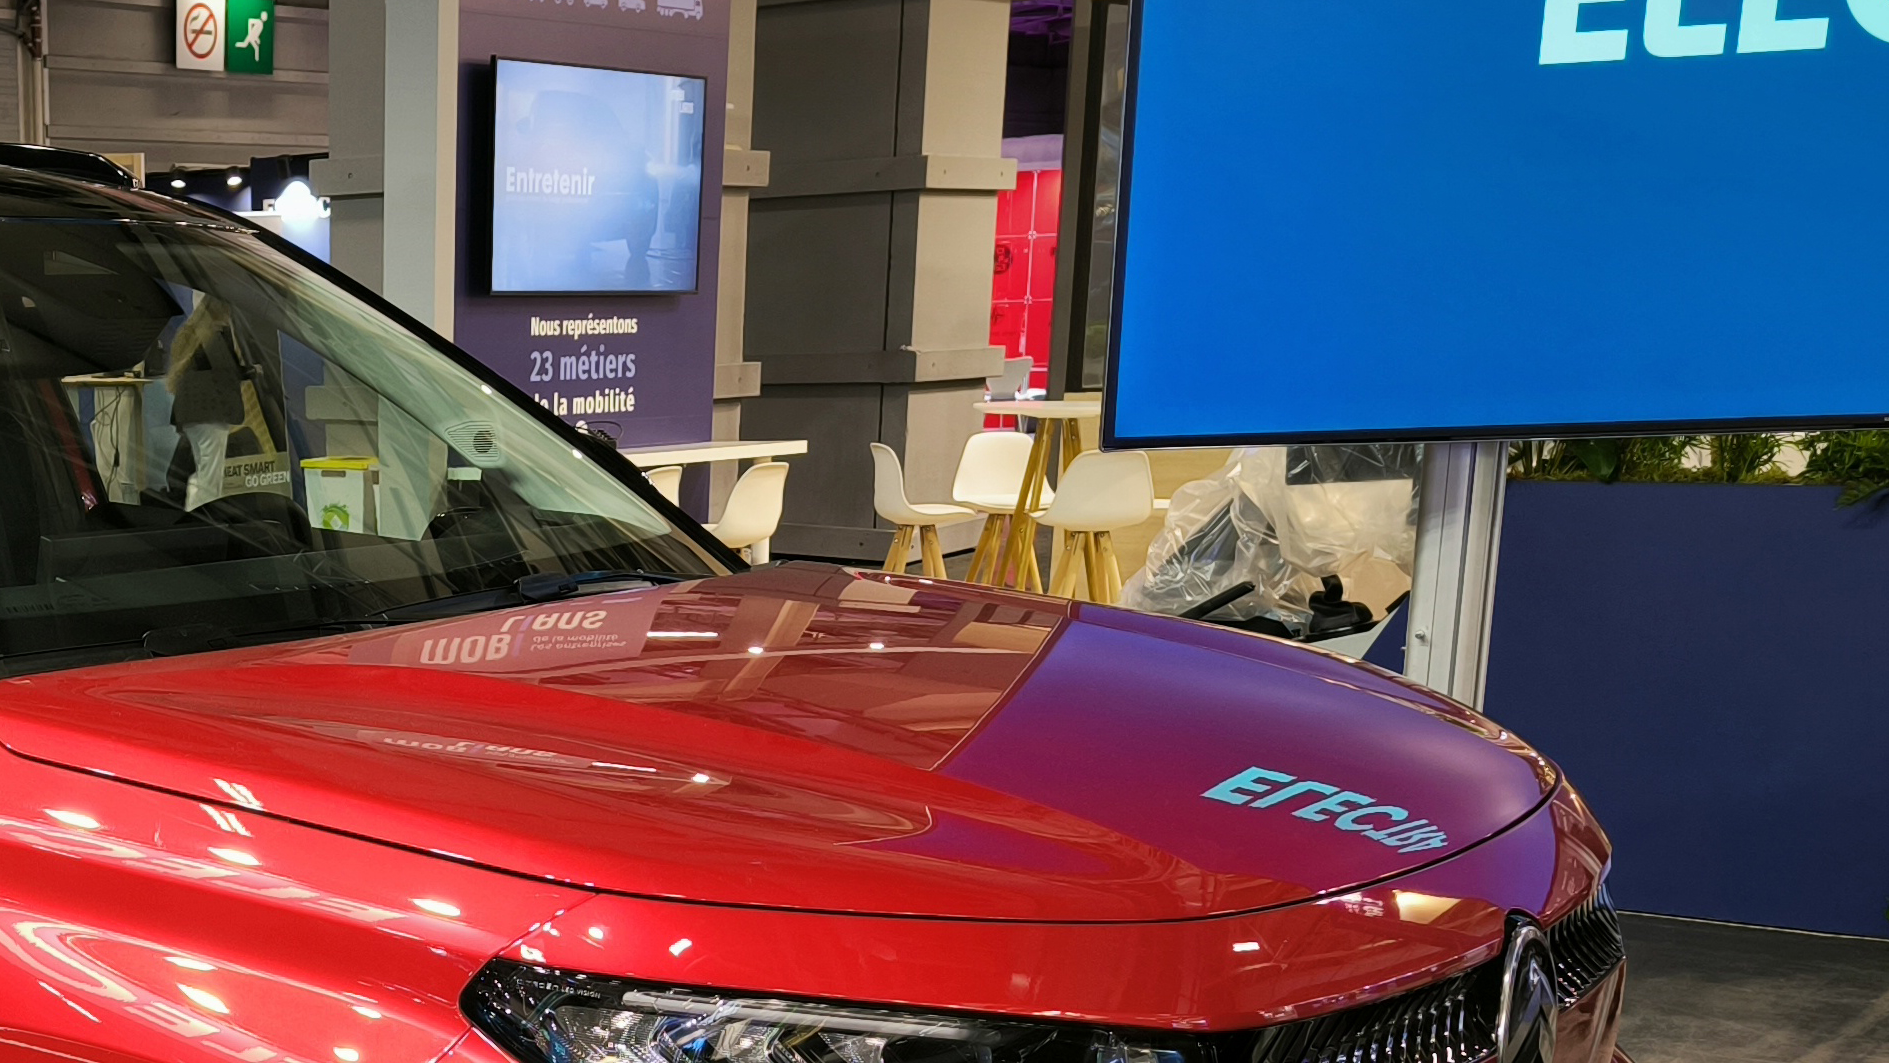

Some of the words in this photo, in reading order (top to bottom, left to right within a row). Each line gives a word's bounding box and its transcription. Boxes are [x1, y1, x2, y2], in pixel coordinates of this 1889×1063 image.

[506, 166, 596, 196] Entretenir
[530, 316, 560, 337] Nous
[562, 312, 638, 340] représentons
[529, 350, 554, 382] 23
[559, 344, 637, 381] métiers
[553, 392, 568, 416] la
[572, 386, 636, 415] mobilité
[243, 460, 276, 477] SMART
